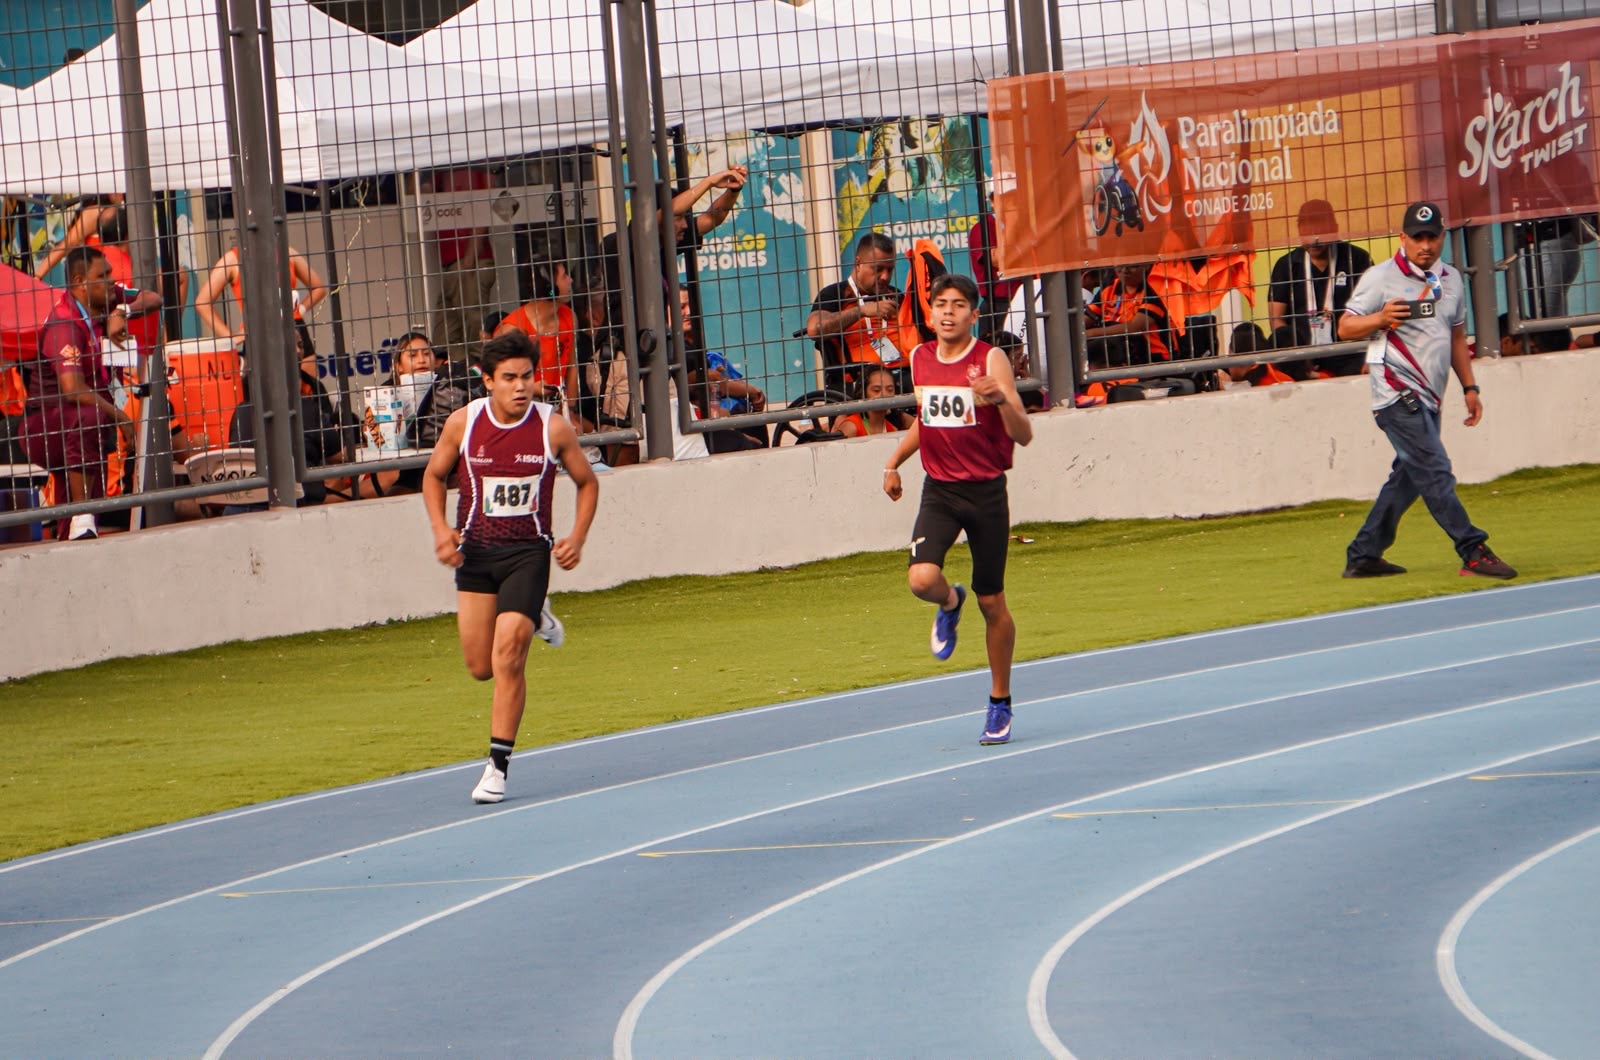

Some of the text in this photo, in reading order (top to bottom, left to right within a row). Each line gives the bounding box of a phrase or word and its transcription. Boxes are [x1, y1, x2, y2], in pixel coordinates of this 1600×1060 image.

[1520, 123, 1588, 175] TWIST
[1182, 146, 1292, 191] Nacional
[437, 208, 462, 218] CODE
[1184, 191, 1274, 218] CONADE 2026
[208, 360, 231, 381] NL
[929, 395, 965, 418] 560
[493, 484, 531, 507] 487
